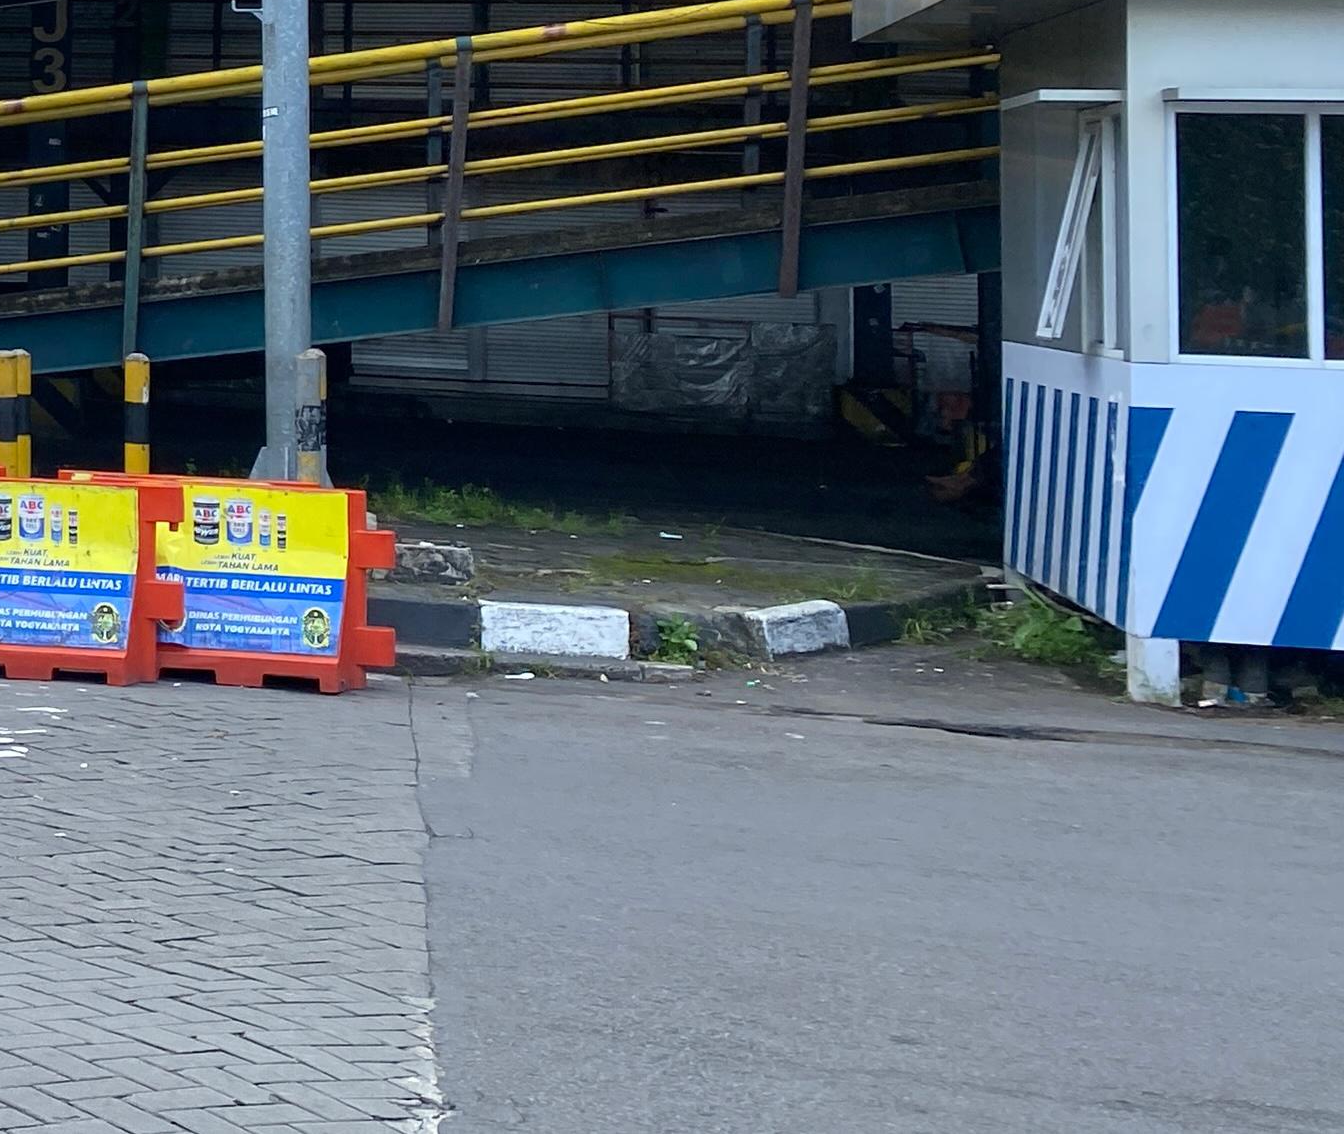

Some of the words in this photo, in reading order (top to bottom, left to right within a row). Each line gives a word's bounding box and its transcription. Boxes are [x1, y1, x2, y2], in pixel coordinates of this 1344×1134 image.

[32, 47, 68, 94] 3
[20, 500, 43, 509] ABC
[228, 505, 252, 514] ABC
[195, 509, 217, 517] ABC
[10, 557, 40, 566] TAHAN
[43, 559, 70, 567] LAMA
[218, 561, 250, 570] TAHAN
[23, 574, 77, 588] BERLALU
[79, 577, 122, 591] LINTAS
[186, 577, 228, 589] TERTIB
[231, 578, 286, 593] BERLALU
[289, 582, 332, 595] LINTAS
[188, 610, 219, 619] DINAS
[221, 612, 298, 625] PERHUBUNGAN
[14, 620, 80, 632] YOGYAKARTA
[195, 623, 222, 632] KOTA
[224, 624, 290, 636] YOGYAKARTA
